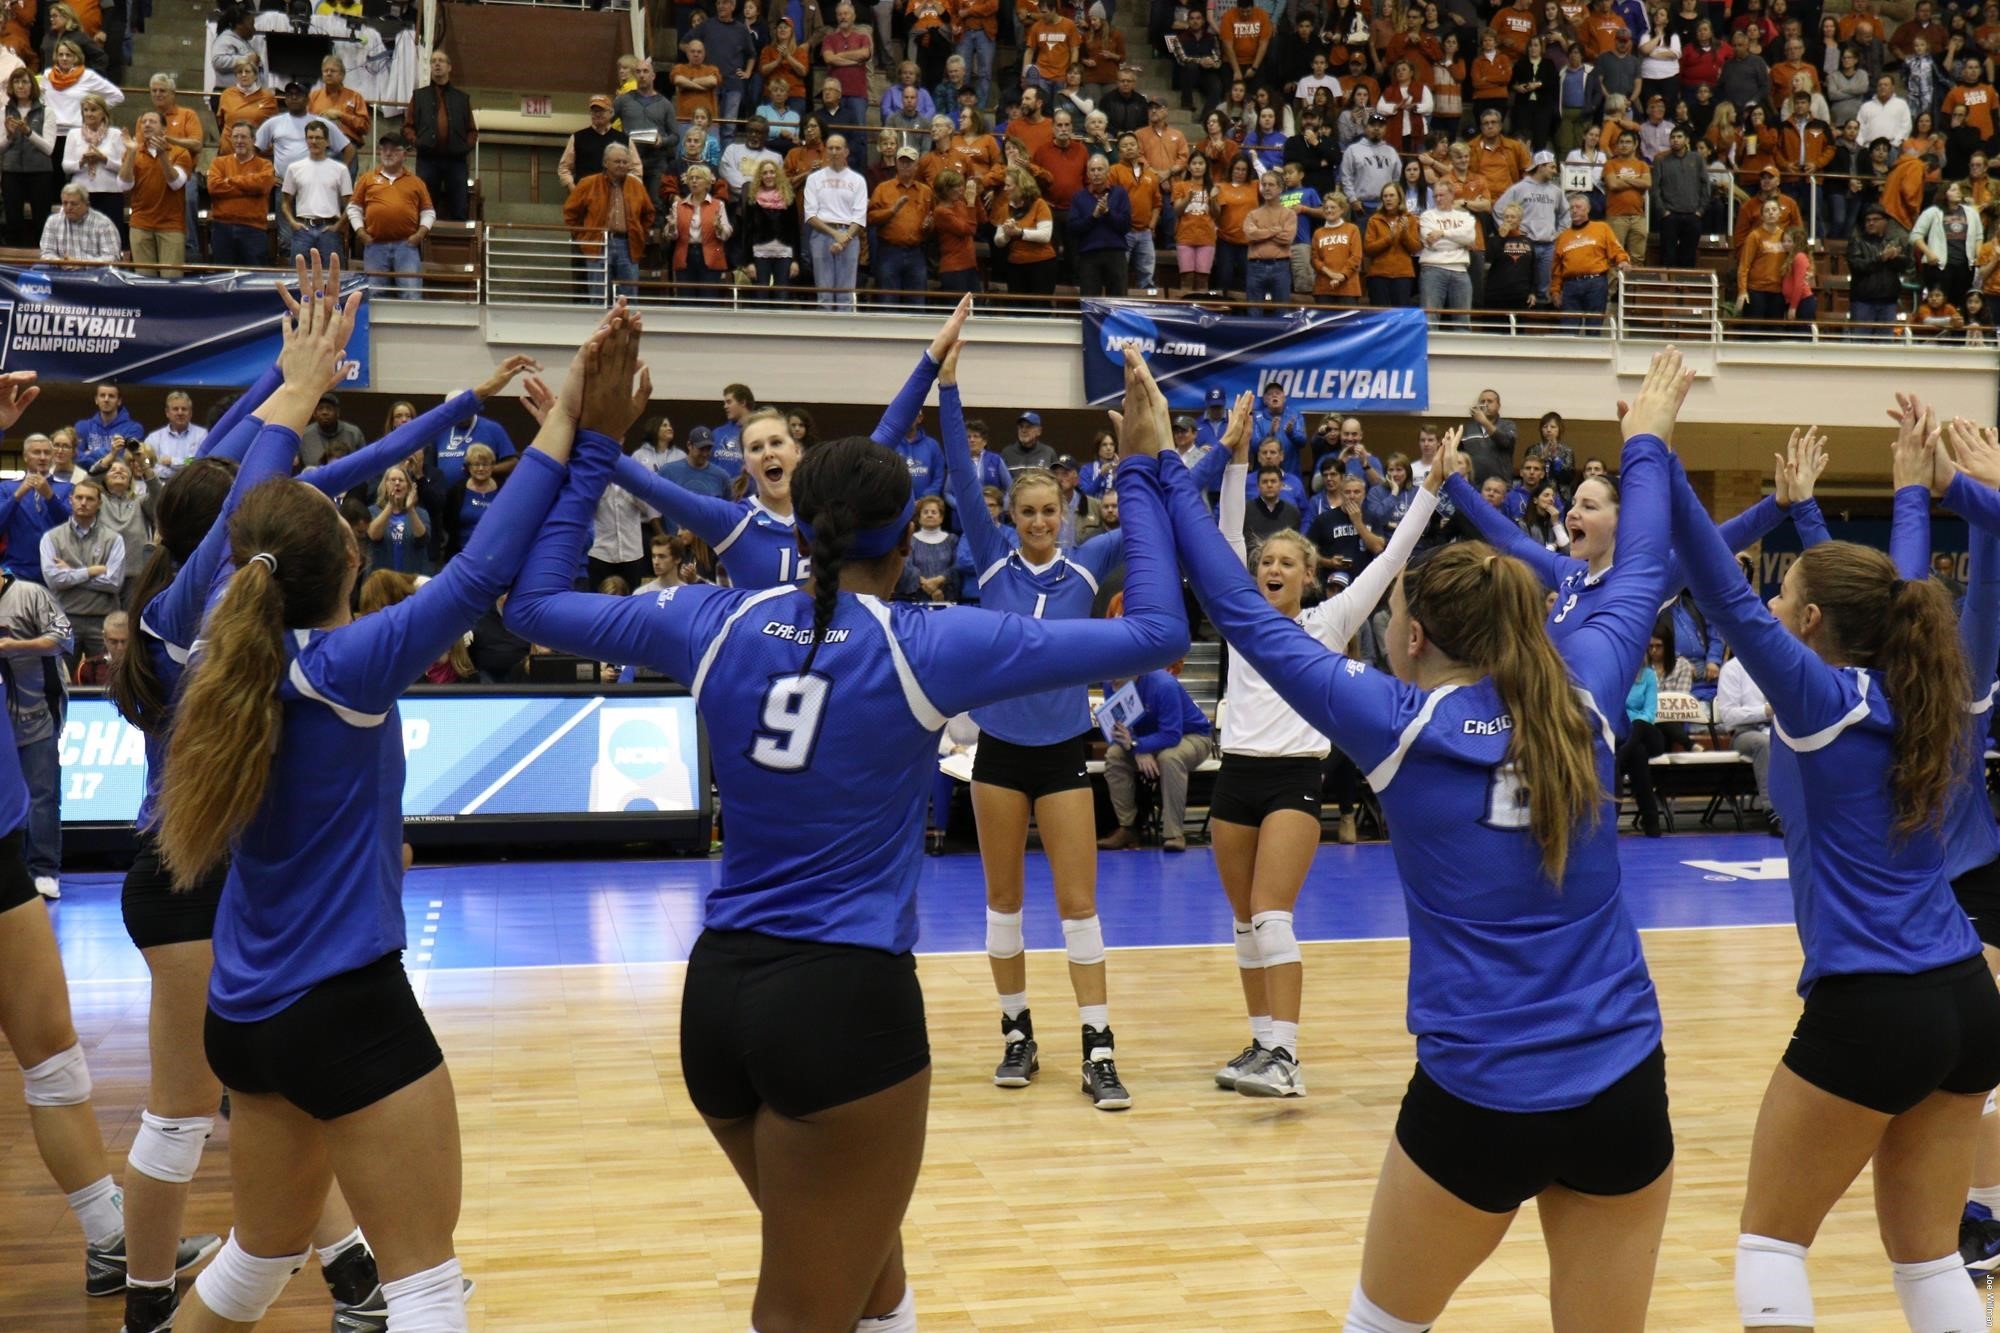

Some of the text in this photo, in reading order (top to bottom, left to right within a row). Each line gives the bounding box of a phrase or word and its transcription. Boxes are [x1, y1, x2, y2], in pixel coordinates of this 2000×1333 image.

[1234, 22, 1261, 35] TEXAS
[1506, 17, 1532, 28] TEXAS
[525, 96, 548, 115] EXIT
[818, 178, 858, 192] TEXAS
[1571, 175, 1586, 187] 44
[1319, 234, 1348, 247] TEXAS
[20, 283, 52, 295] NCAA
[18, 303, 43, 312] 2016
[44, 304, 88, 315] DIVISION
[98, 308, 141, 317] WOMEN'S
[15, 312, 136, 339] VOLLEYBALL
[12, 336, 120, 354] CHAMPIONSHIP
[1256, 368, 1416, 399] VOLLEYBALL
[1033, 593, 1047, 619] 1
[1553, 593, 1578, 623] 3
[750, 674, 830, 770] 9
[70, 773, 102, 800] 17
